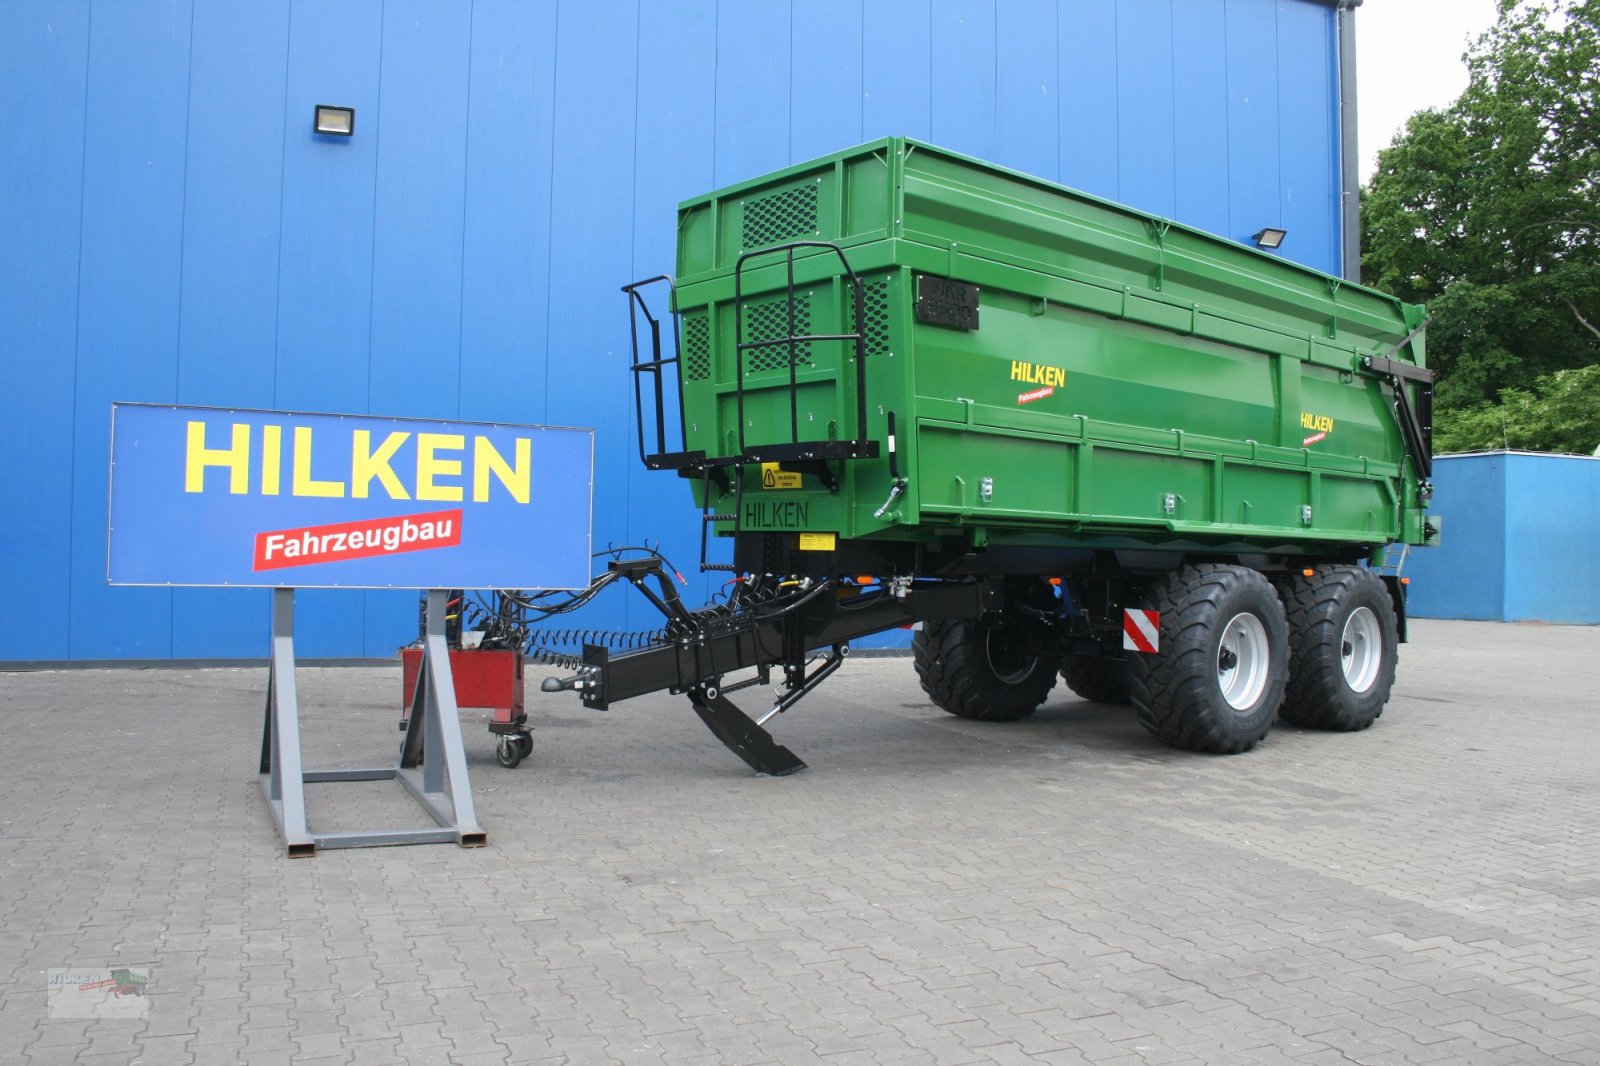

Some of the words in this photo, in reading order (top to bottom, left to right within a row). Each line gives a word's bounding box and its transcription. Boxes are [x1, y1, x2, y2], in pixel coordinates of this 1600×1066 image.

[1011, 360, 1065, 388] HILKEN
[1300, 412, 1334, 433] HILKEN
[185, 421, 532, 504] HILKEN
[746, 502, 808, 528] HILKEN
[264, 519, 453, 560] Fahrzeugbau
